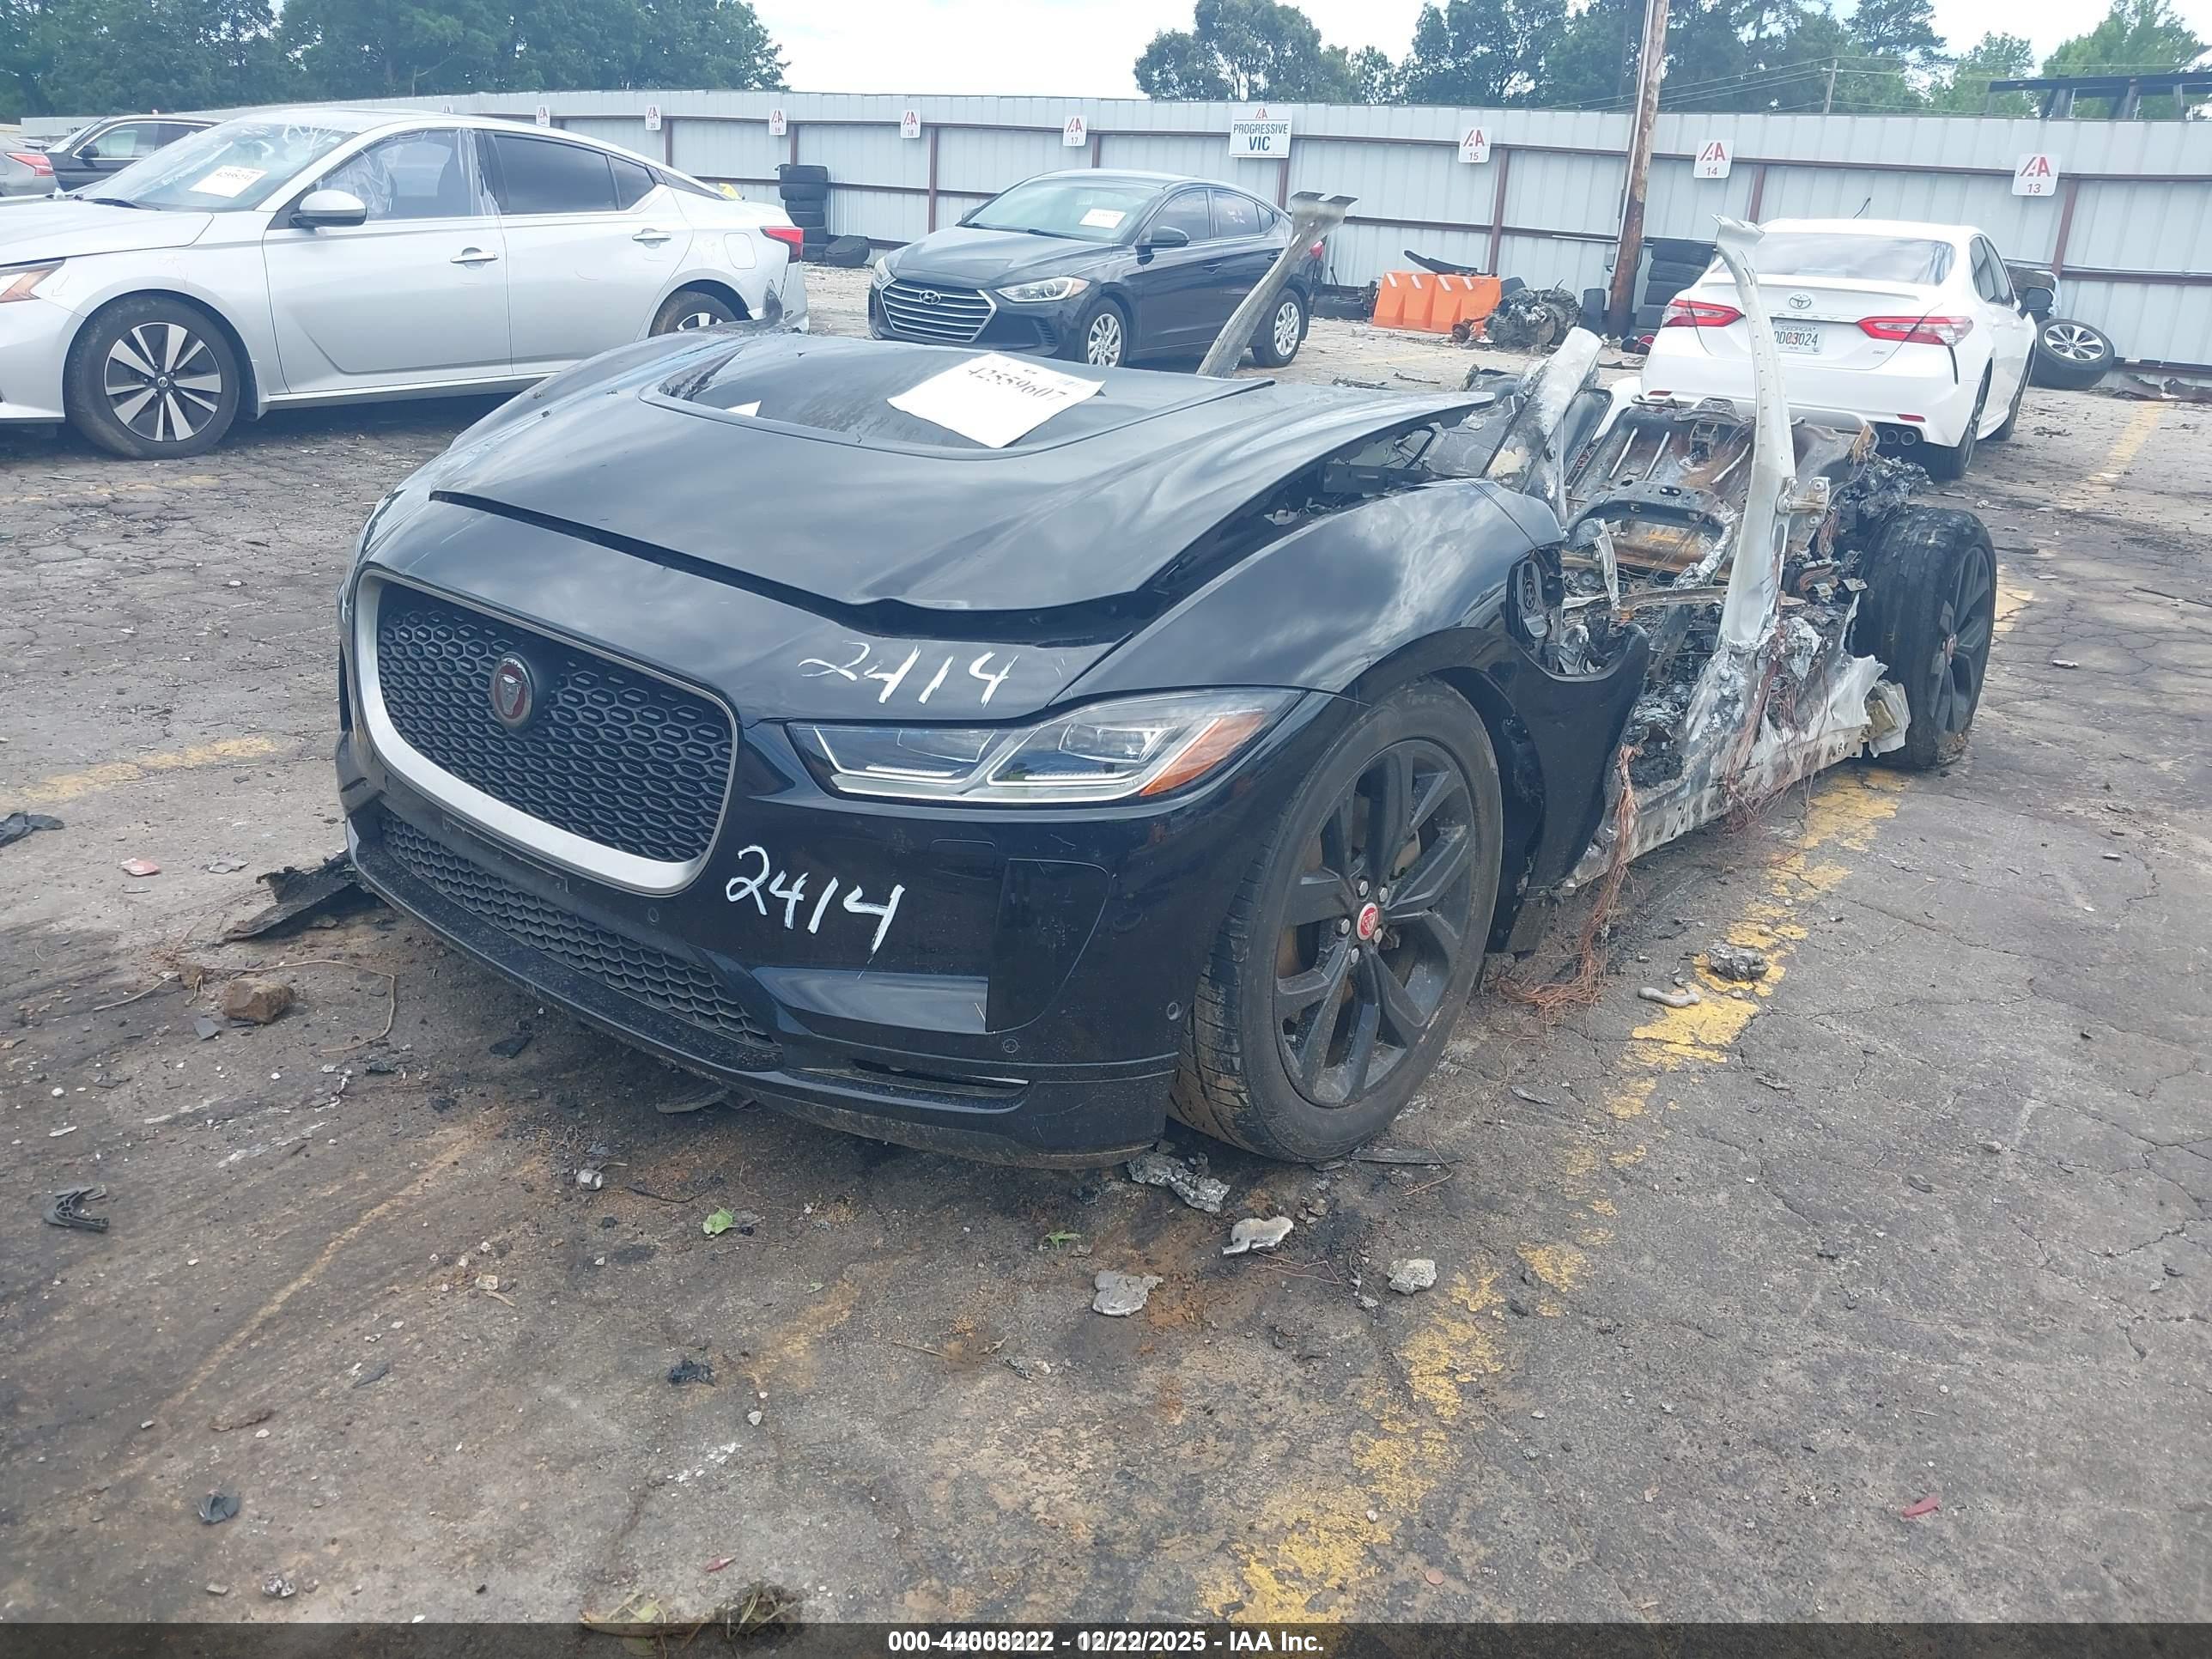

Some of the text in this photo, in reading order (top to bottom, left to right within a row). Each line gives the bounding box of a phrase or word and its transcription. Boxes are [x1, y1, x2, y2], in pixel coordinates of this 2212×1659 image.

[1233, 124, 1288, 134] PROGRESSIVE
[1249, 136, 1271, 151] VIC
[1469, 151, 1479, 161] 15
[1706, 167, 1717, 176] 14
[2027, 183, 2041, 193] 13
[797, 640, 1020, 709] 2414
[726, 844, 906, 964] 2414
